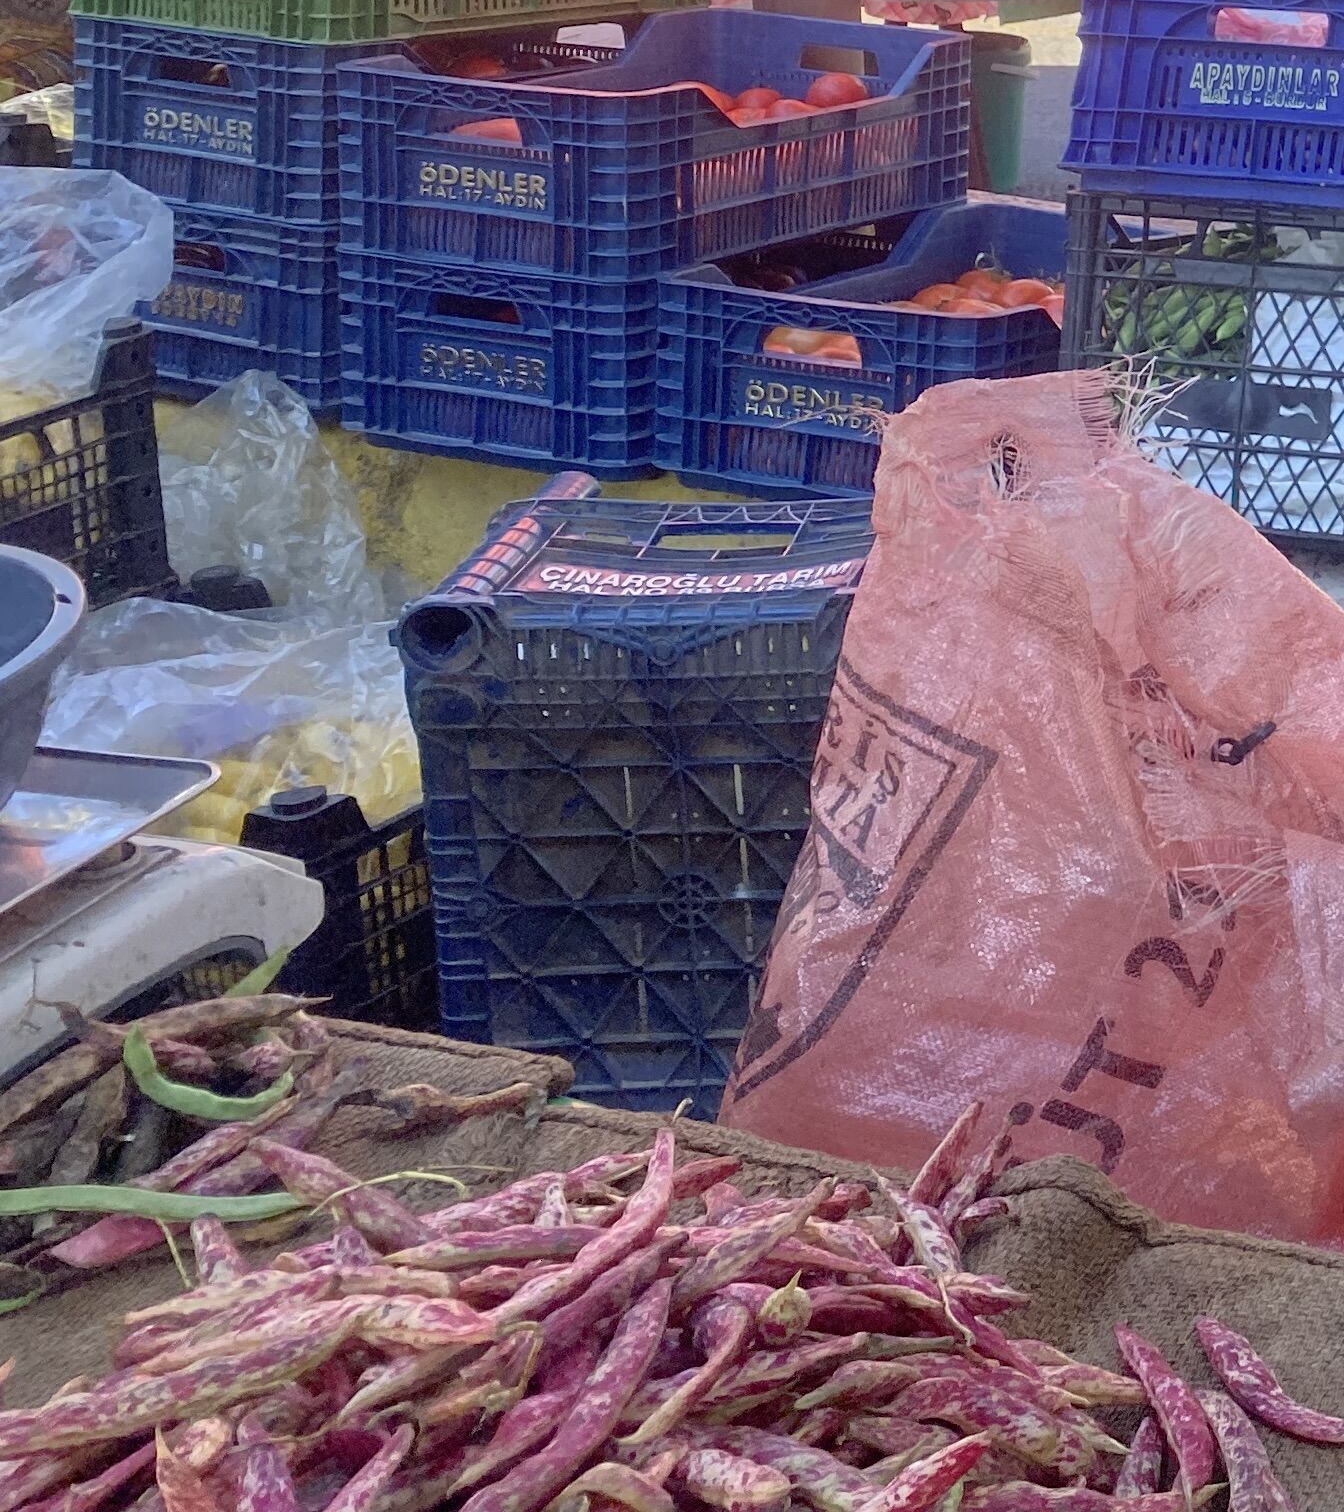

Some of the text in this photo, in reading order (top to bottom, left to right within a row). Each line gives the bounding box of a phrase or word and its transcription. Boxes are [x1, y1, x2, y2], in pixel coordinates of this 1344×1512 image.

[1190, 62, 1340, 97] APAYDINLAR
[143, 106, 253, 141] ÖDENLER
[419, 161, 547, 196] ÖDENLER
[753, 561, 852, 587] TARIM
